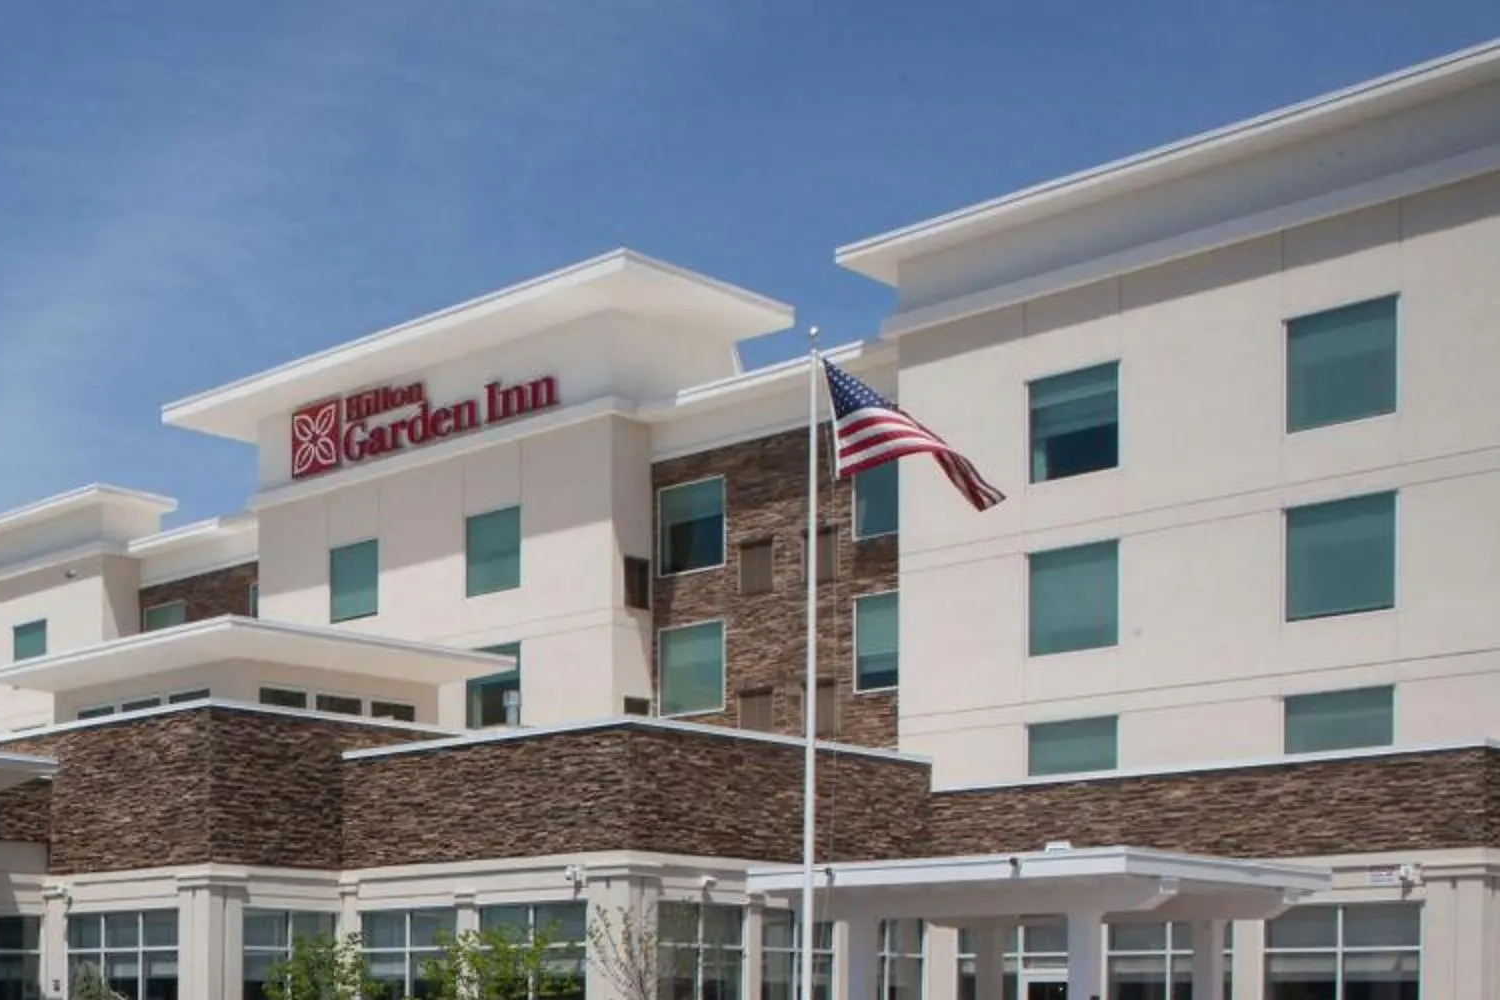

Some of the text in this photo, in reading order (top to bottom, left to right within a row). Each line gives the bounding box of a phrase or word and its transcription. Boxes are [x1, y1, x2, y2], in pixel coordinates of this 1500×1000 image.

[343, 375, 560, 461] Garden Inn
[345, 381, 424, 421] Hilton
